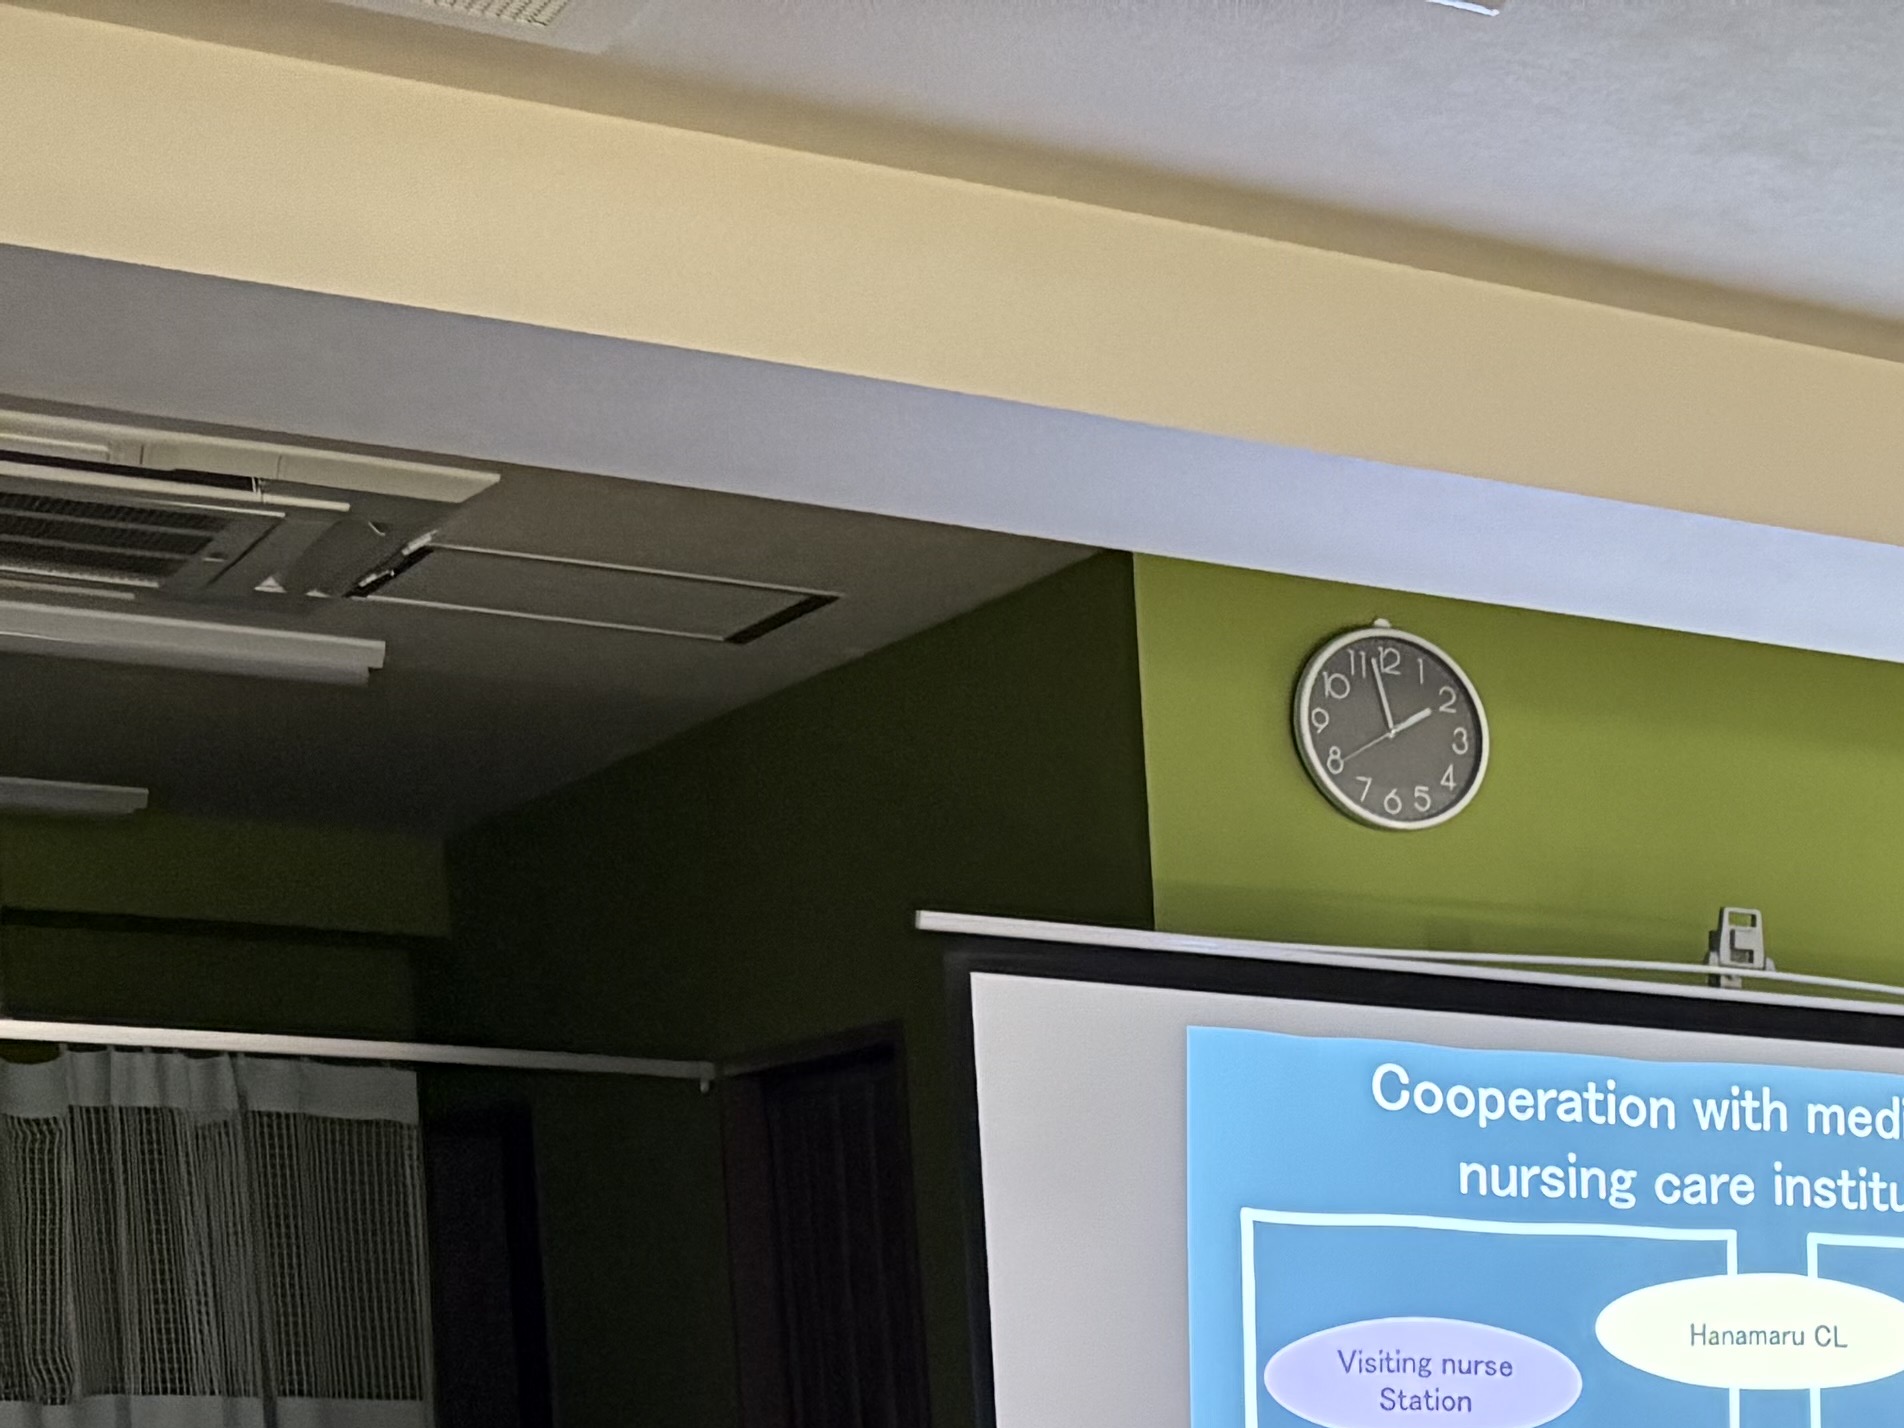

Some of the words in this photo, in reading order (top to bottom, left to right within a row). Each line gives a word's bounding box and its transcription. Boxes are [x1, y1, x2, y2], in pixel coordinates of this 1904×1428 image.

[1350, 650, 1366, 678] 11
[1378, 647, 1401, 675] 12
[1417, 658, 1424, 684] 1
[1323, 671, 1350, 699] 10
[1439, 686, 1457, 713] 2
[1311, 708, 1329, 734] 9
[1452, 727, 1468, 755] 3
[1327, 746, 1344, 774] 8
[1356, 776, 1372, 802] 7
[1440, 764, 1457, 791] 4
[1383, 789, 1402, 814] 6
[1414, 786, 1431, 812] 5
[1371, 1063, 1677, 1131] Cooperation
[1693, 1085, 1787, 1132] with
[1459, 1155, 1638, 1210] nursing
[1655, 1173, 1754, 1205] care
[1691, 1323, 1804, 1346] Hanamaru
[1815, 1325, 1847, 1348] CL
[1337, 1349, 1432, 1378] Visiting
[1442, 1359, 1512, 1377] nurse
[1380, 1387, 1471, 1412] Station
